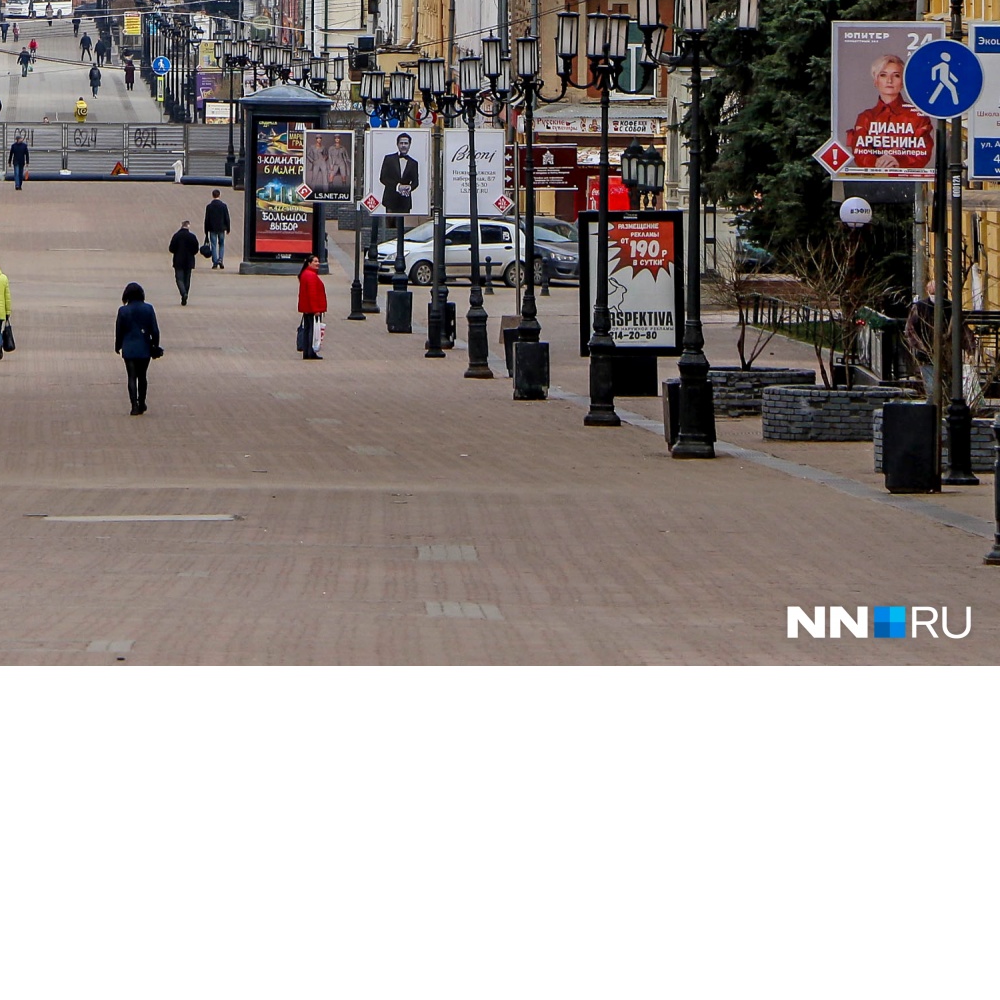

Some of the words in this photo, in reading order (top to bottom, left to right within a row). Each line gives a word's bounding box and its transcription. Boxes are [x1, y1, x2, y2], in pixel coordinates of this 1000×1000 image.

[844, 32, 890, 40] ЮПИТЕР
[868, 121, 915, 136] ДИАНА
[73, 127, 98, 148] 624
[855, 135, 927, 149] АРБЕНИНА
[853, 146, 928, 157] #ночныеснайперы
[264, 164, 271, 174] 6
[314, 192, 350, 200] LS.NET.RU
[261, 211, 308, 222] БОЛЬШОЙ
[269, 221, 299, 231] ВЫБОР
[617, 222, 660, 231] РАЗМЕЩЕНИЕ
[629, 239, 660, 259] 190
